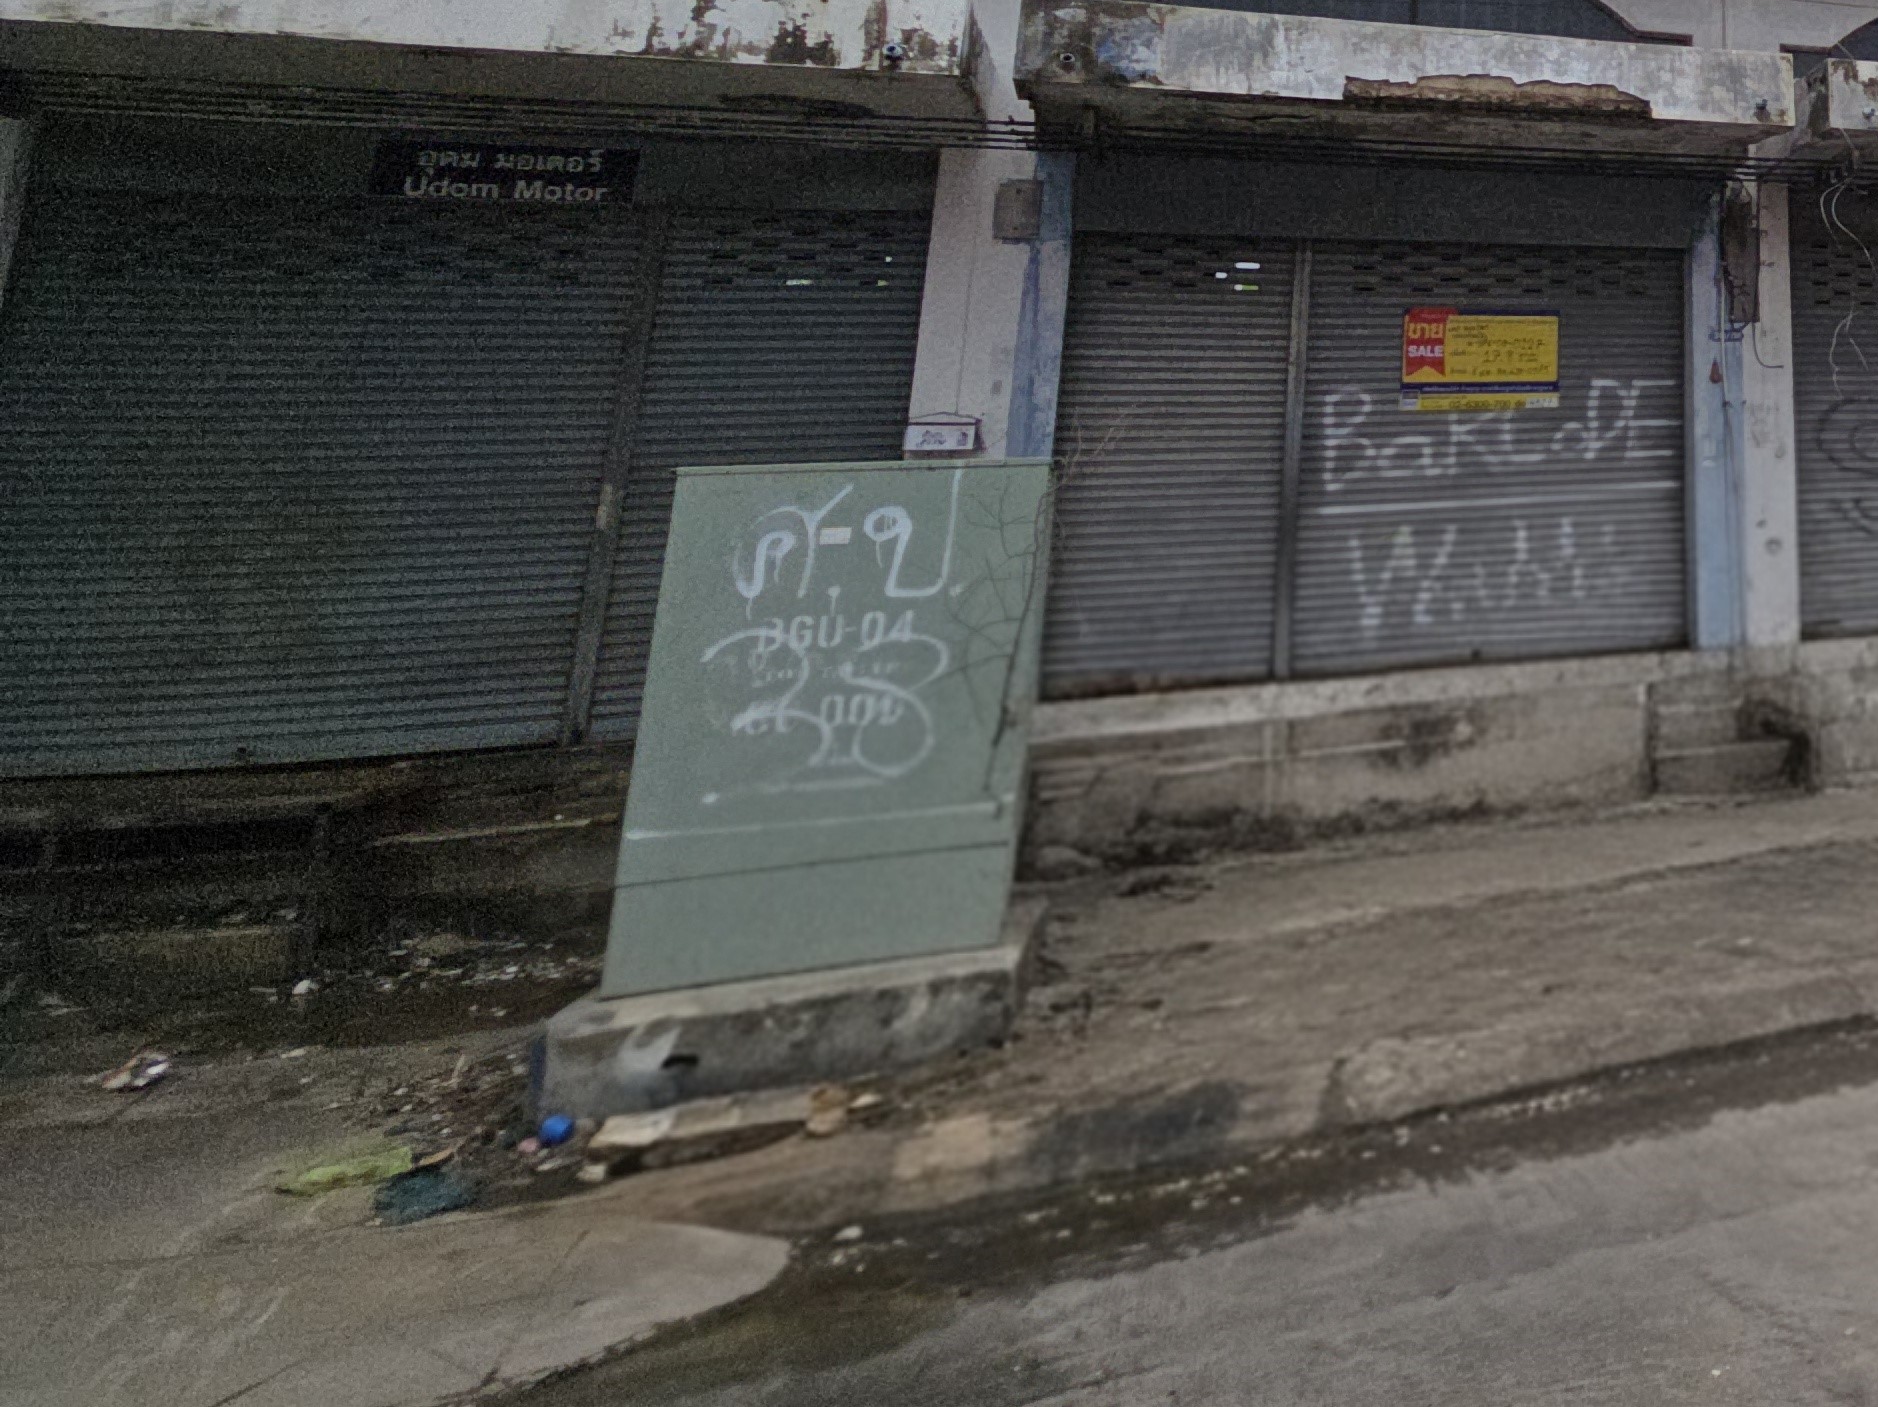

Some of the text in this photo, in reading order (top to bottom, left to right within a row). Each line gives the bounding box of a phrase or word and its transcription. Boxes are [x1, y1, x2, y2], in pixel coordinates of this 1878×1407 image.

[402, 174, 610, 203] Udom Motor
[1407, 322, 1444, 340] ขาย
[1407, 345, 1444, 358] SALE
